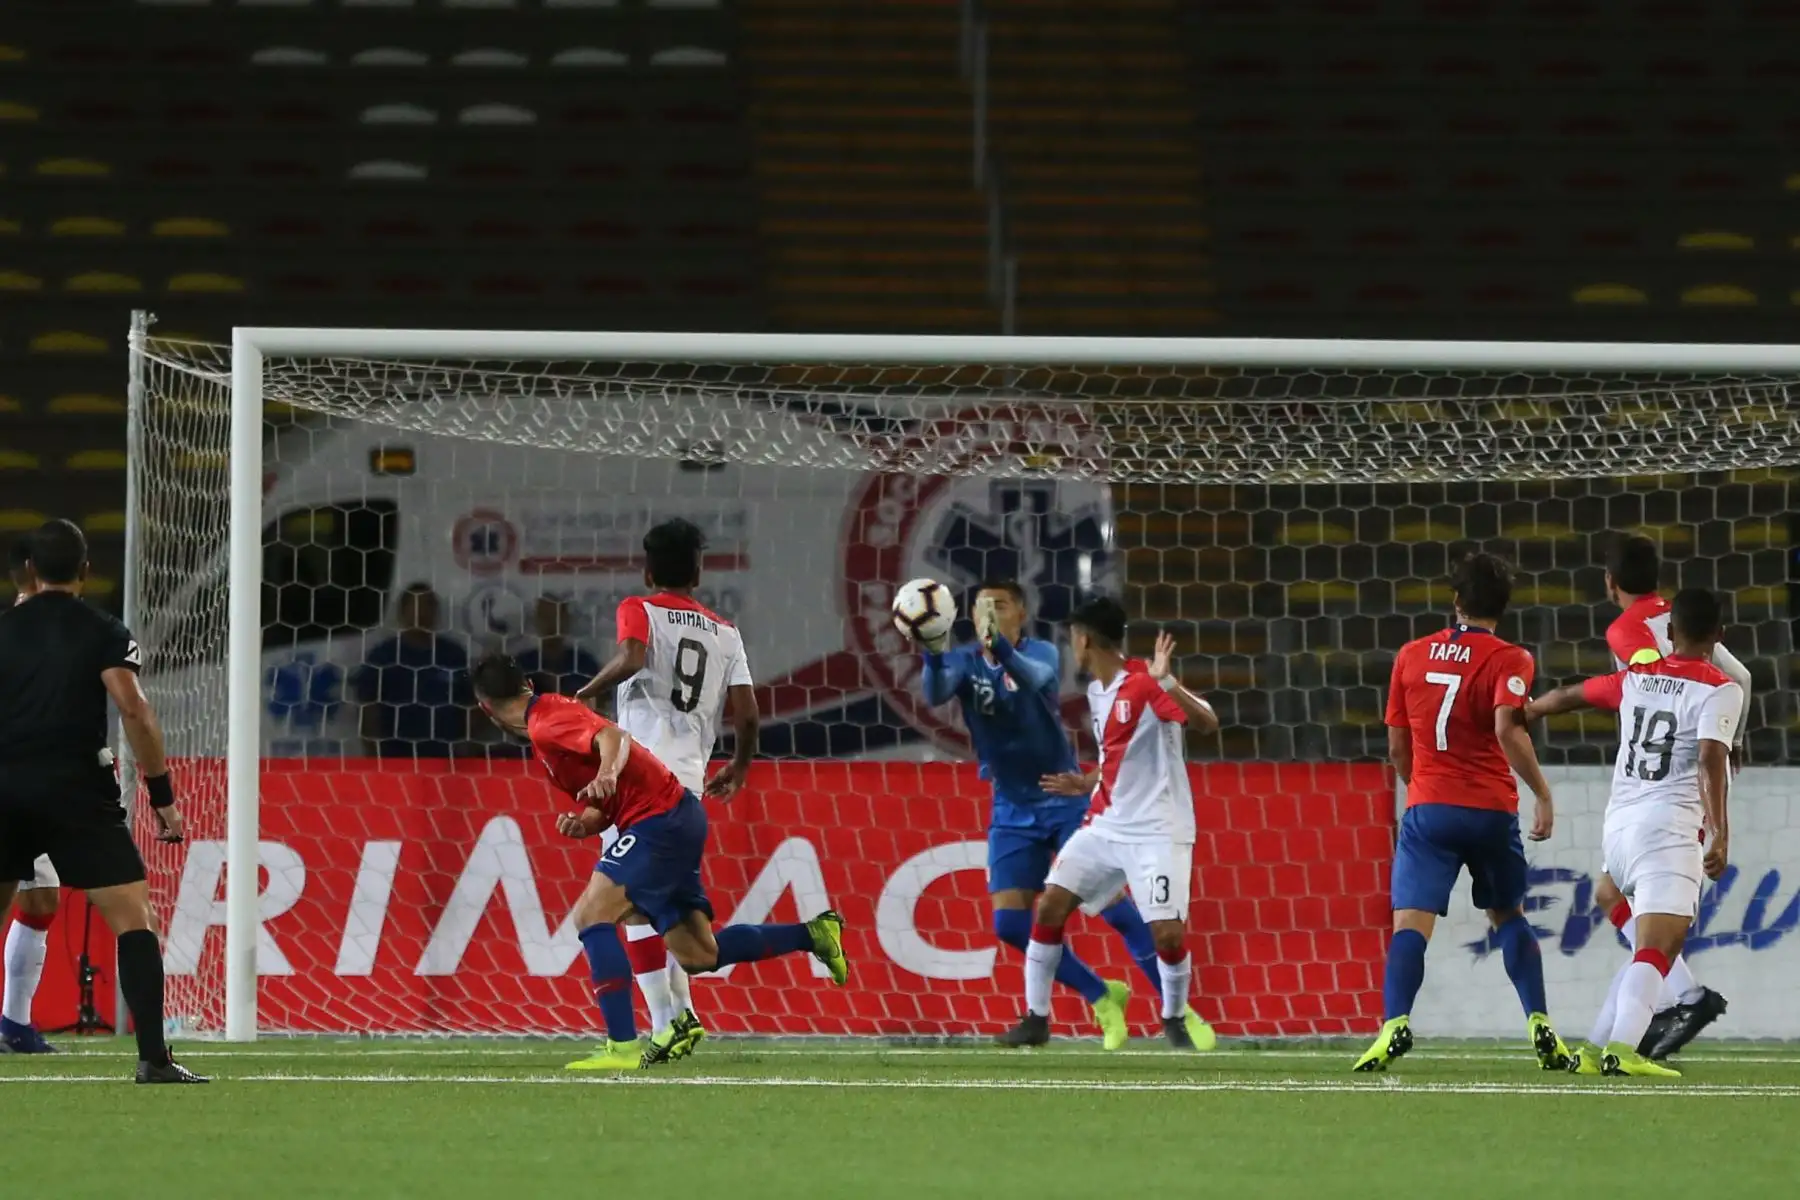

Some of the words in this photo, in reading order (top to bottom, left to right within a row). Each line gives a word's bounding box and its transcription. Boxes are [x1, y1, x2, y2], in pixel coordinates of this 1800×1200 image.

[1429, 641, 1472, 664] TAPIA
[670, 637, 708, 714] 9
[1640, 676, 1686, 697] MONTOYA
[972, 682, 996, 716] 12
[1425, 671, 1463, 752] 7
[1624, 705, 1679, 782] 19
[610, 833, 638, 859] 9
[1149, 874, 1170, 905] 13
